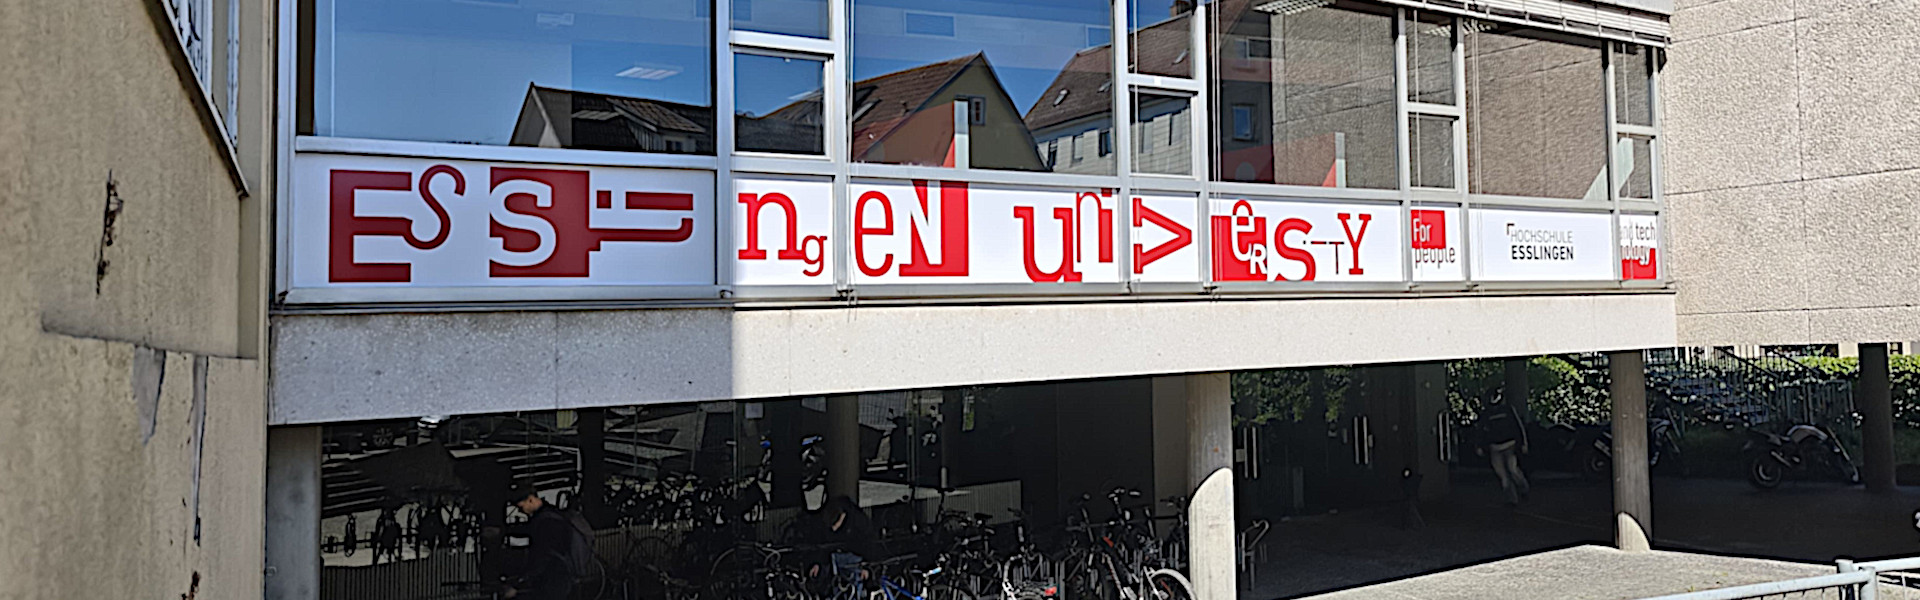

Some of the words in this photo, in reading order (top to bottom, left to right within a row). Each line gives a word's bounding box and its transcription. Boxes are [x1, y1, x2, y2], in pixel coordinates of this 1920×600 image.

[1413, 218, 1432, 243] For
[1511, 230, 1574, 244] HOCHSCHULE
[1635, 222, 1656, 241] tech
[1415, 247, 1455, 269] people
[1512, 245, 1574, 261] ESSLINGEN
